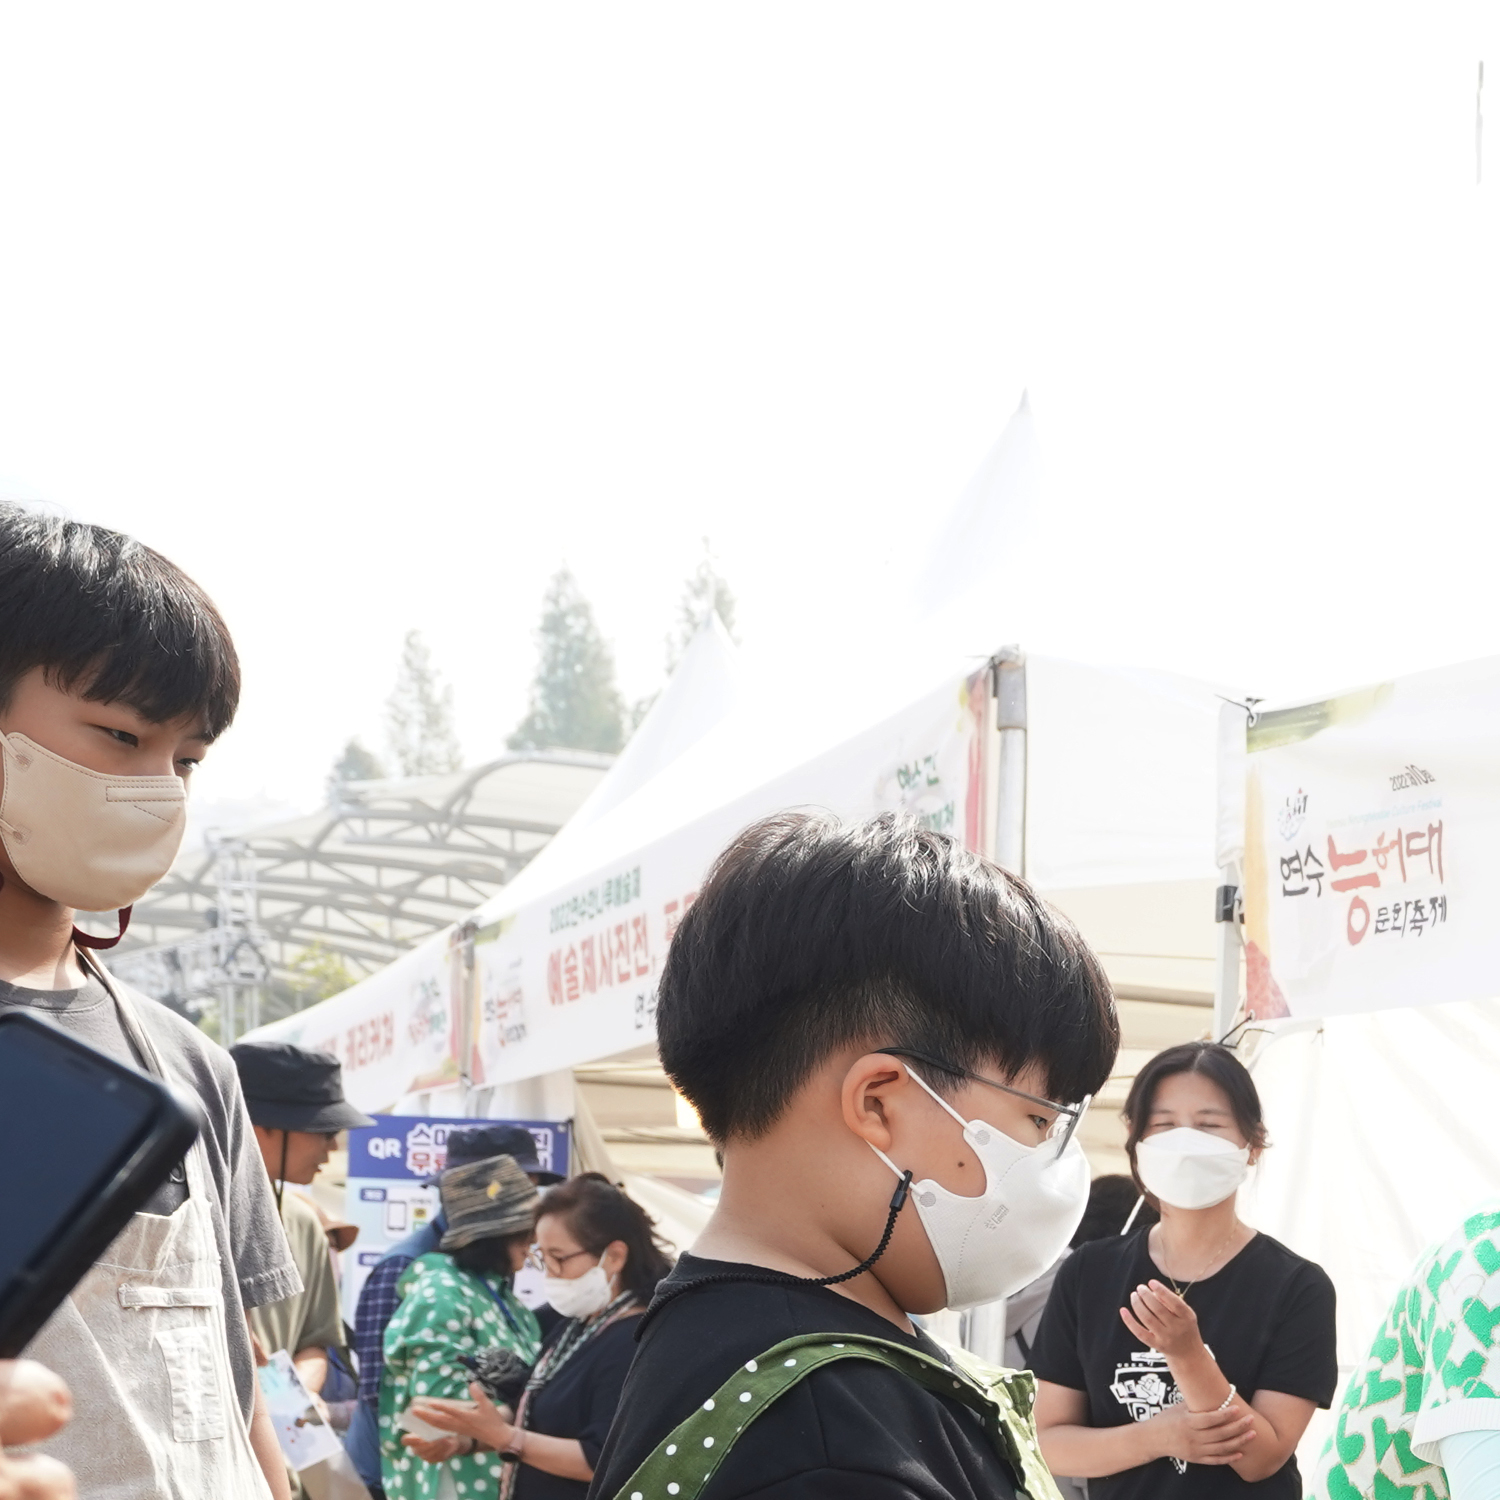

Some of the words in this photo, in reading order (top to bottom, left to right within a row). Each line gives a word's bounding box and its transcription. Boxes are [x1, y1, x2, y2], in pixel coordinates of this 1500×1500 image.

[1280, 844, 1325, 898] 연수
[1328, 819, 1444, 946] 능허대
[1374, 895, 1448, 938] 문화축제
[368, 1137, 402, 1160] QR
